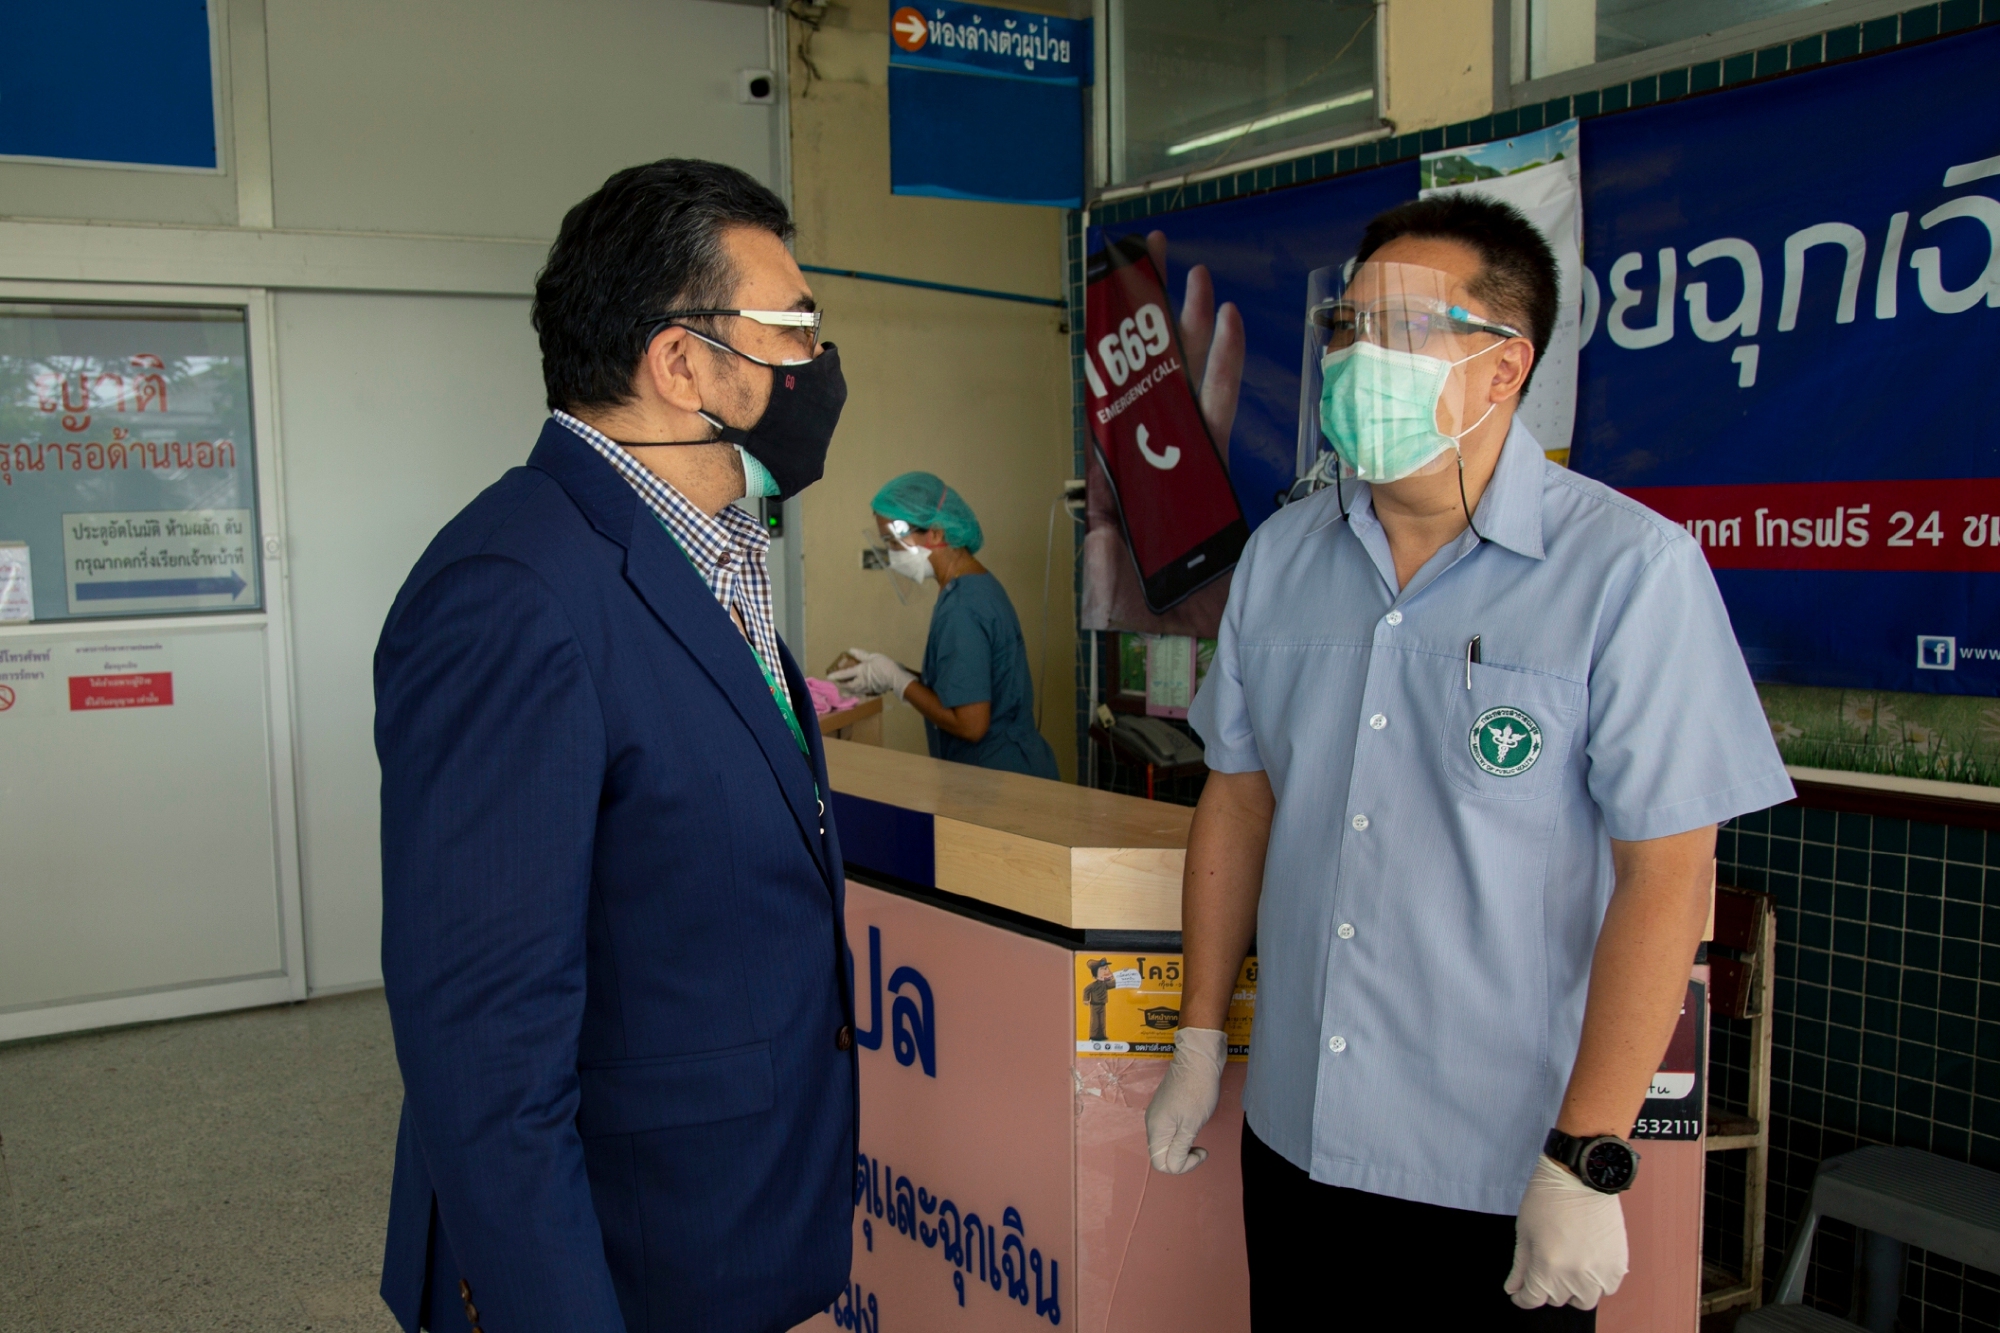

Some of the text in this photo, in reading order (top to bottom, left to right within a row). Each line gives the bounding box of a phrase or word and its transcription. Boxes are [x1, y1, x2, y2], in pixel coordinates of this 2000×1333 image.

[927, 8, 1071, 71] ห้องล้างตัวผู้ป่วย
[1084, 302, 1170, 399] 1669
[36, 353, 168, 433] ญาติ
[1096, 357, 1181, 425] EMERGENCY CALL
[0, 427, 236, 486] รุณารอด้านนอก
[72, 518, 161, 547] ประตูอัตโนมัติ
[1755, 504, 1871, 548] โทรฟรี
[1886, 510, 1944, 547] 24
